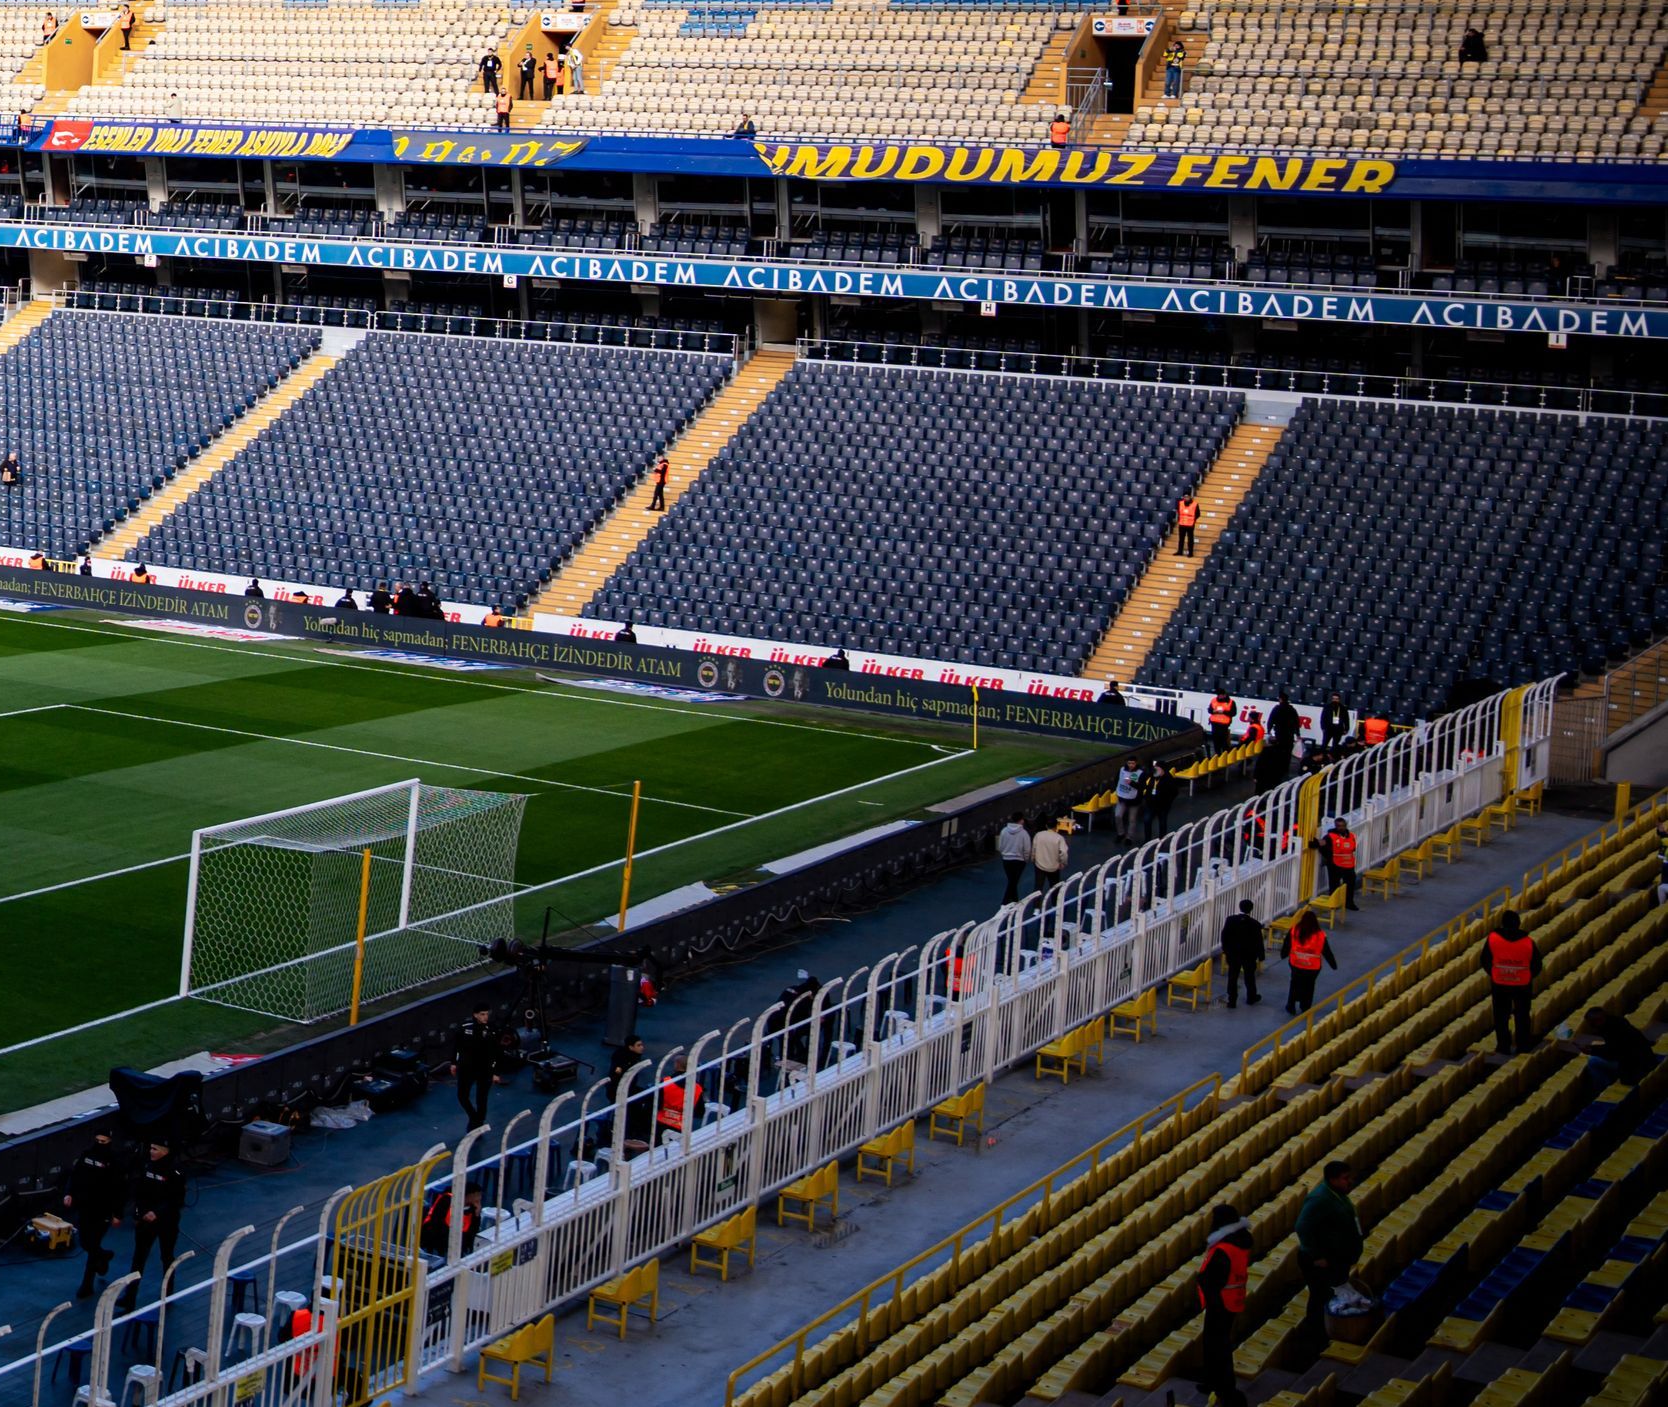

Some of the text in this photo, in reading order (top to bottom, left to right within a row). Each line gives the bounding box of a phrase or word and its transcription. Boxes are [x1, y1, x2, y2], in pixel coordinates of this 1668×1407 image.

[185, 129, 243, 154] FENER
[1166, 155, 1395, 193] FENER
[9, 228, 153, 253] ACIBADEM
[175, 236, 321, 263] ACIBADEM
[347, 246, 503, 274] ACIBADEM
[529, 256, 695, 284] ACIBADEM
[723, 266, 903, 295] ACIBADEM
[934, 277, 1128, 308] ACIBADEM
[1161, 288, 1374, 322] ACIBADEM
[1411, 301, 1648, 336] ACIBADEM
[984, 302, 993, 313] H
[178, 575, 226, 592] ÜLKER
[34, 581, 116, 605] FENERBAHÇE
[119, 590, 186, 613] İZİNDEDİR
[191, 603, 228, 619] ATAM
[362, 620, 682, 677] hiç sapmadan; FENERBAHÇE İZİNDEDİR ATAM
[862, 659, 924, 680] ÜLKER
[940, 669, 1004, 690] ÜLKER
[1028, 679, 1094, 702] ÜLKER
[825, 681, 891, 705] Yolundan
[896, 688, 916, 713] hiç
[1005, 704, 1122, 738] FENERBAHÇE
